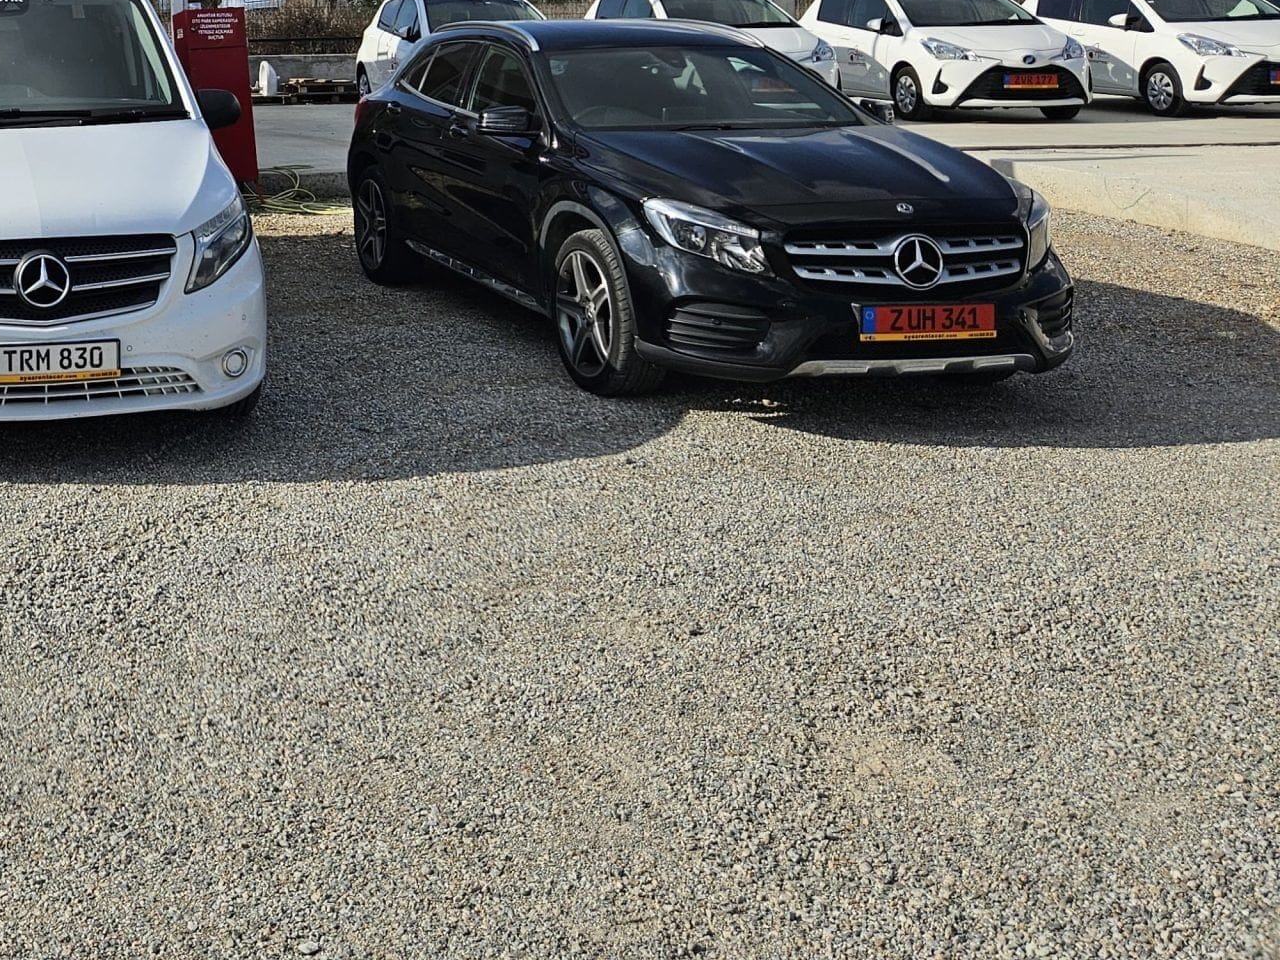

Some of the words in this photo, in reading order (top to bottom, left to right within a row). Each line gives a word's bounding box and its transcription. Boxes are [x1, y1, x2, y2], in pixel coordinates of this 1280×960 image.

[942, 307, 979, 329] 341
[3, 348, 51, 372] TRM
[59, 346, 103, 369] 830
